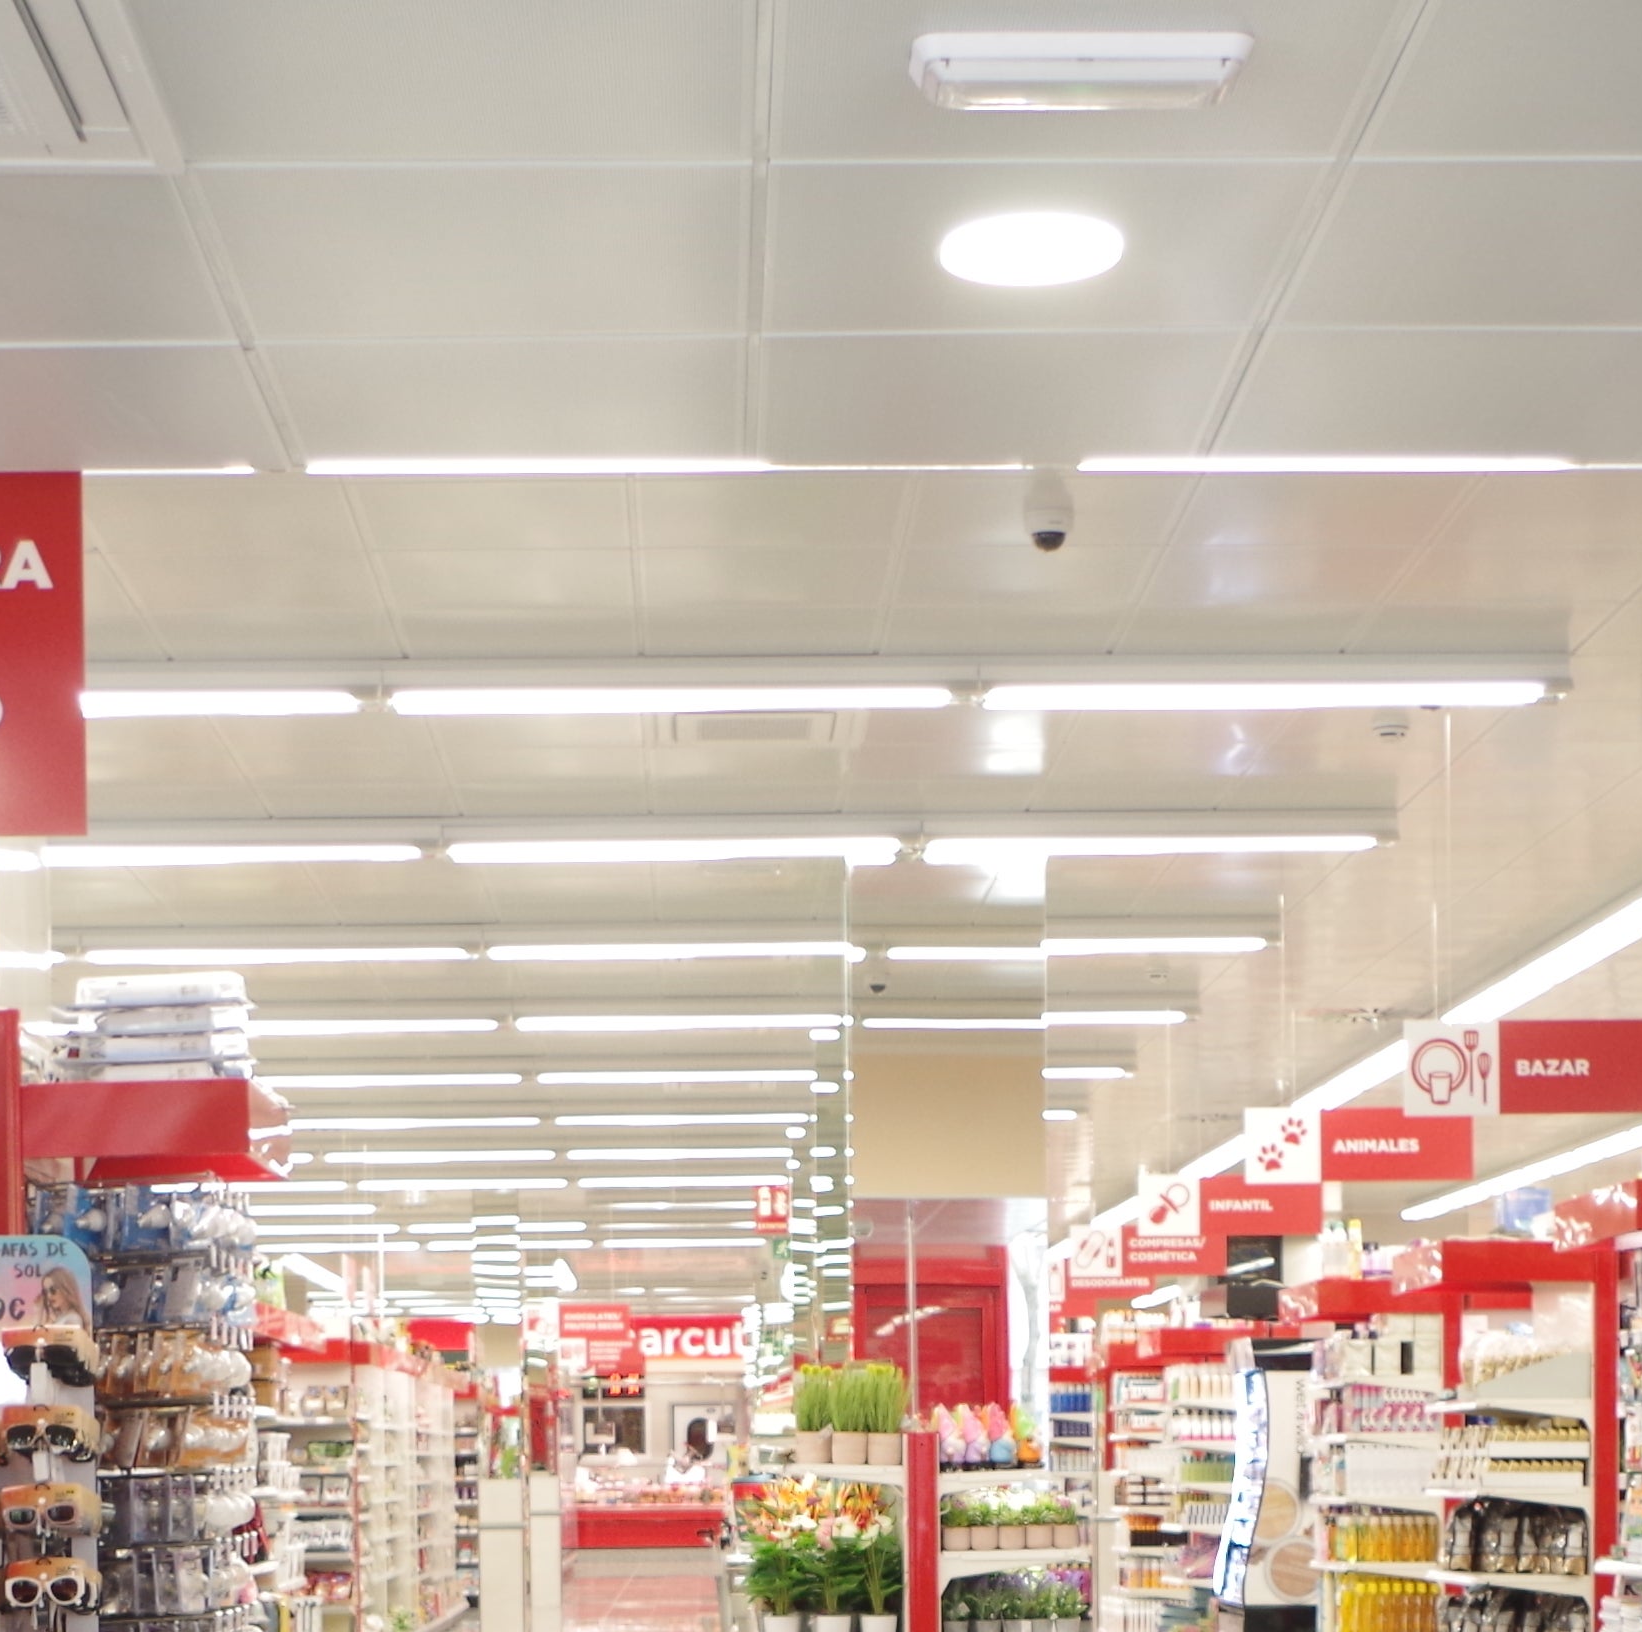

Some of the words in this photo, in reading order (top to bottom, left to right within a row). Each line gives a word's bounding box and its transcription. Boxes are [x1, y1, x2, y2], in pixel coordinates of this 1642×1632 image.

[1515, 1059, 1590, 1077] BAZAR
[1333, 1138, 1420, 1154] ANIMALES
[1209, 1199, 1274, 1212] INFANTIL
[1129, 1236, 1206, 1249] COMPRESAS/
[46, 1242, 68, 1258] DE
[1129, 1250, 1197, 1263] COSMÉTICA
[13, 1263, 42, 1279] SOL
[1071, 1278, 1150, 1288] DESODORANTES
